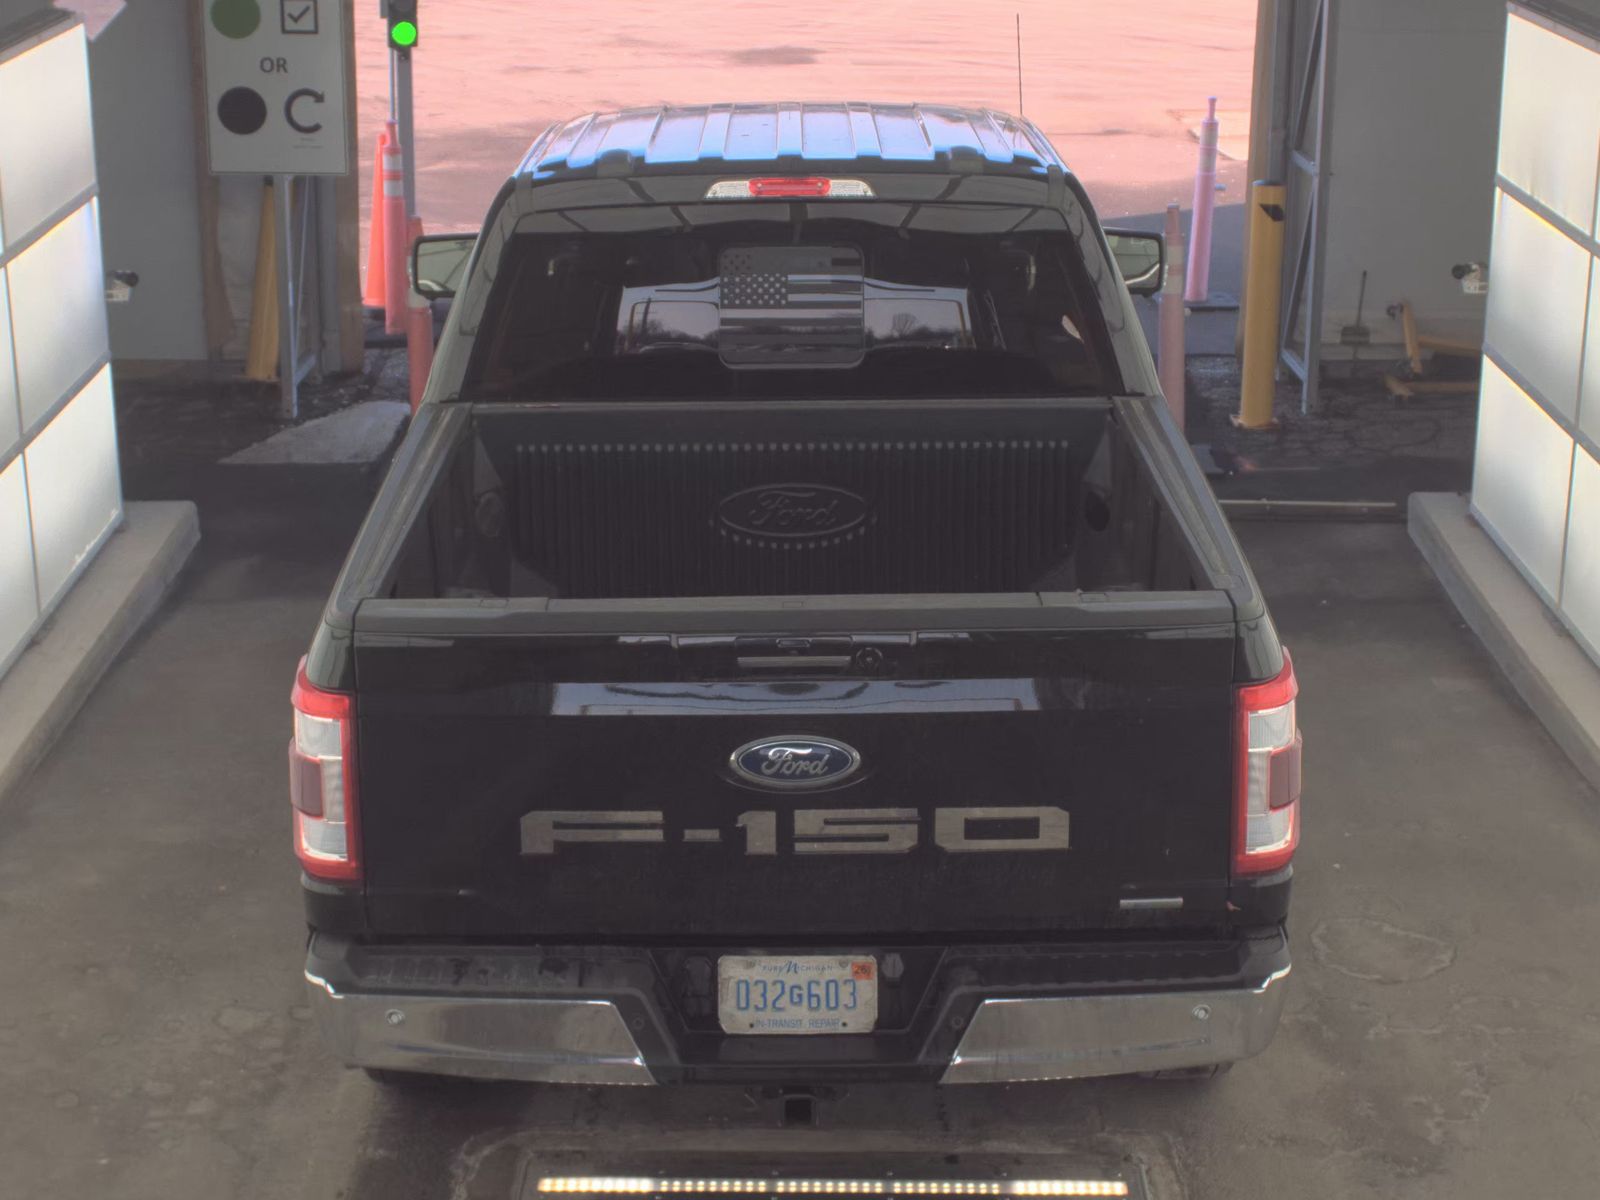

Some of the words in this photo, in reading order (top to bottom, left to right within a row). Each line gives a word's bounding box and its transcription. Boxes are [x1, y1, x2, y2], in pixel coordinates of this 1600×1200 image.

[259, 56, 288, 74] OR
[747, 490, 839, 526] Ford
[761, 746, 831, 775] Ford
[520, 806, 1071, 856] F-150
[736, 978, 857, 1012] 032G603
[755, 1018, 802, 1029] IN-TRANSIT
